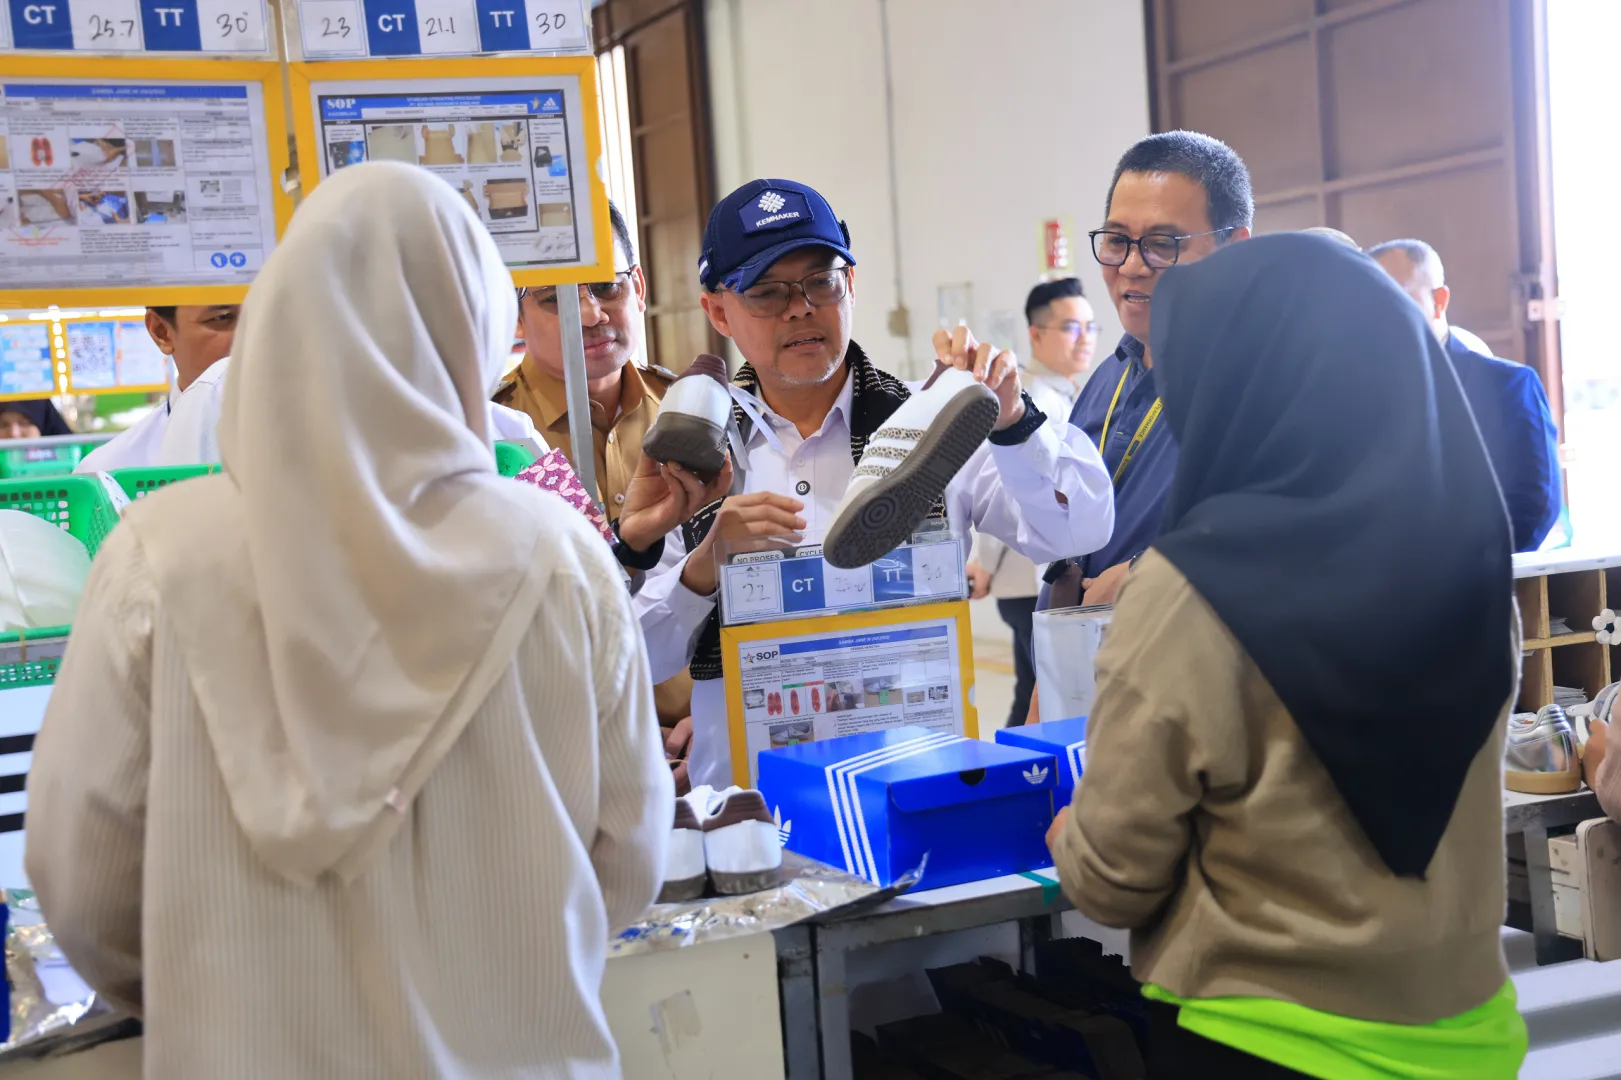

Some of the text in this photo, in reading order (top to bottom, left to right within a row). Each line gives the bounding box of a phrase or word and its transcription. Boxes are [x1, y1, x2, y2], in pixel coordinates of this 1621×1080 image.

[24, 6, 56, 24] CT
[154, 8, 184, 26] TT
[378, 14, 405, 32] CT
[489, 10, 515, 28] TT
[535, 12, 566, 34] 30
[89, 15, 135, 41] 25.7
[321, 17, 351, 38] 23
[425, 17, 456, 36] 21.1
[326, 97, 356, 110] SOP
[756, 211, 799, 227] KEMNAKER
[882, 567, 904, 582] TT
[742, 583, 771, 603] 22
[791, 577, 815, 593] CT
[756, 651, 779, 661] SOP
